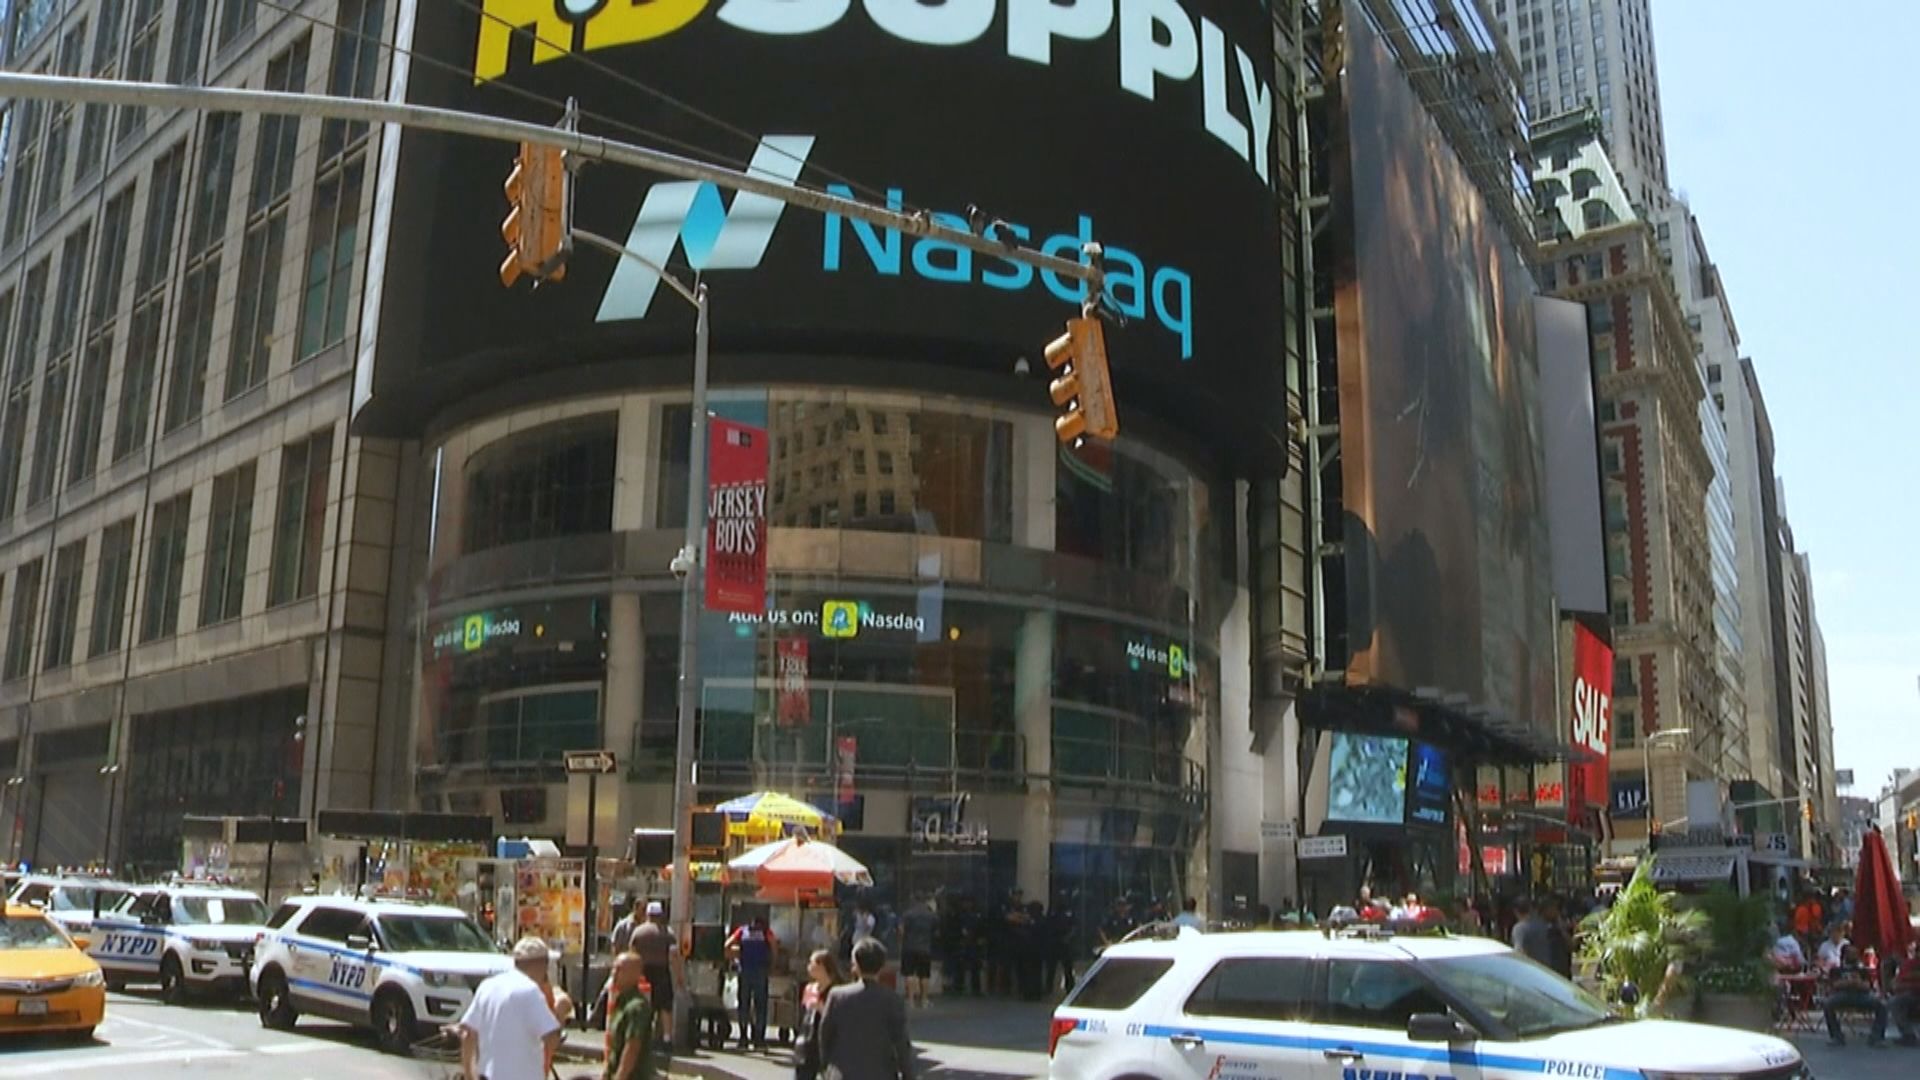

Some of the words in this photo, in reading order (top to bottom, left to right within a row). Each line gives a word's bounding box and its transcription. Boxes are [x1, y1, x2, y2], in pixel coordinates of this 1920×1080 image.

[823, 183, 1192, 360] Nasdaq
[708, 485, 766, 519] JERSEY
[715, 518, 757, 554] BOYS
[768, 610, 787, 624] us
[791, 610, 819, 625] on:
[862, 611, 925, 633] Nasdaq
[1573, 676, 1609, 756] SALE
[1618, 789, 1641, 809] GAP
[101, 933, 158, 956] NYPD
[329, 959, 366, 988] NYPD
[1547, 1060, 1603, 1080] POLICE
